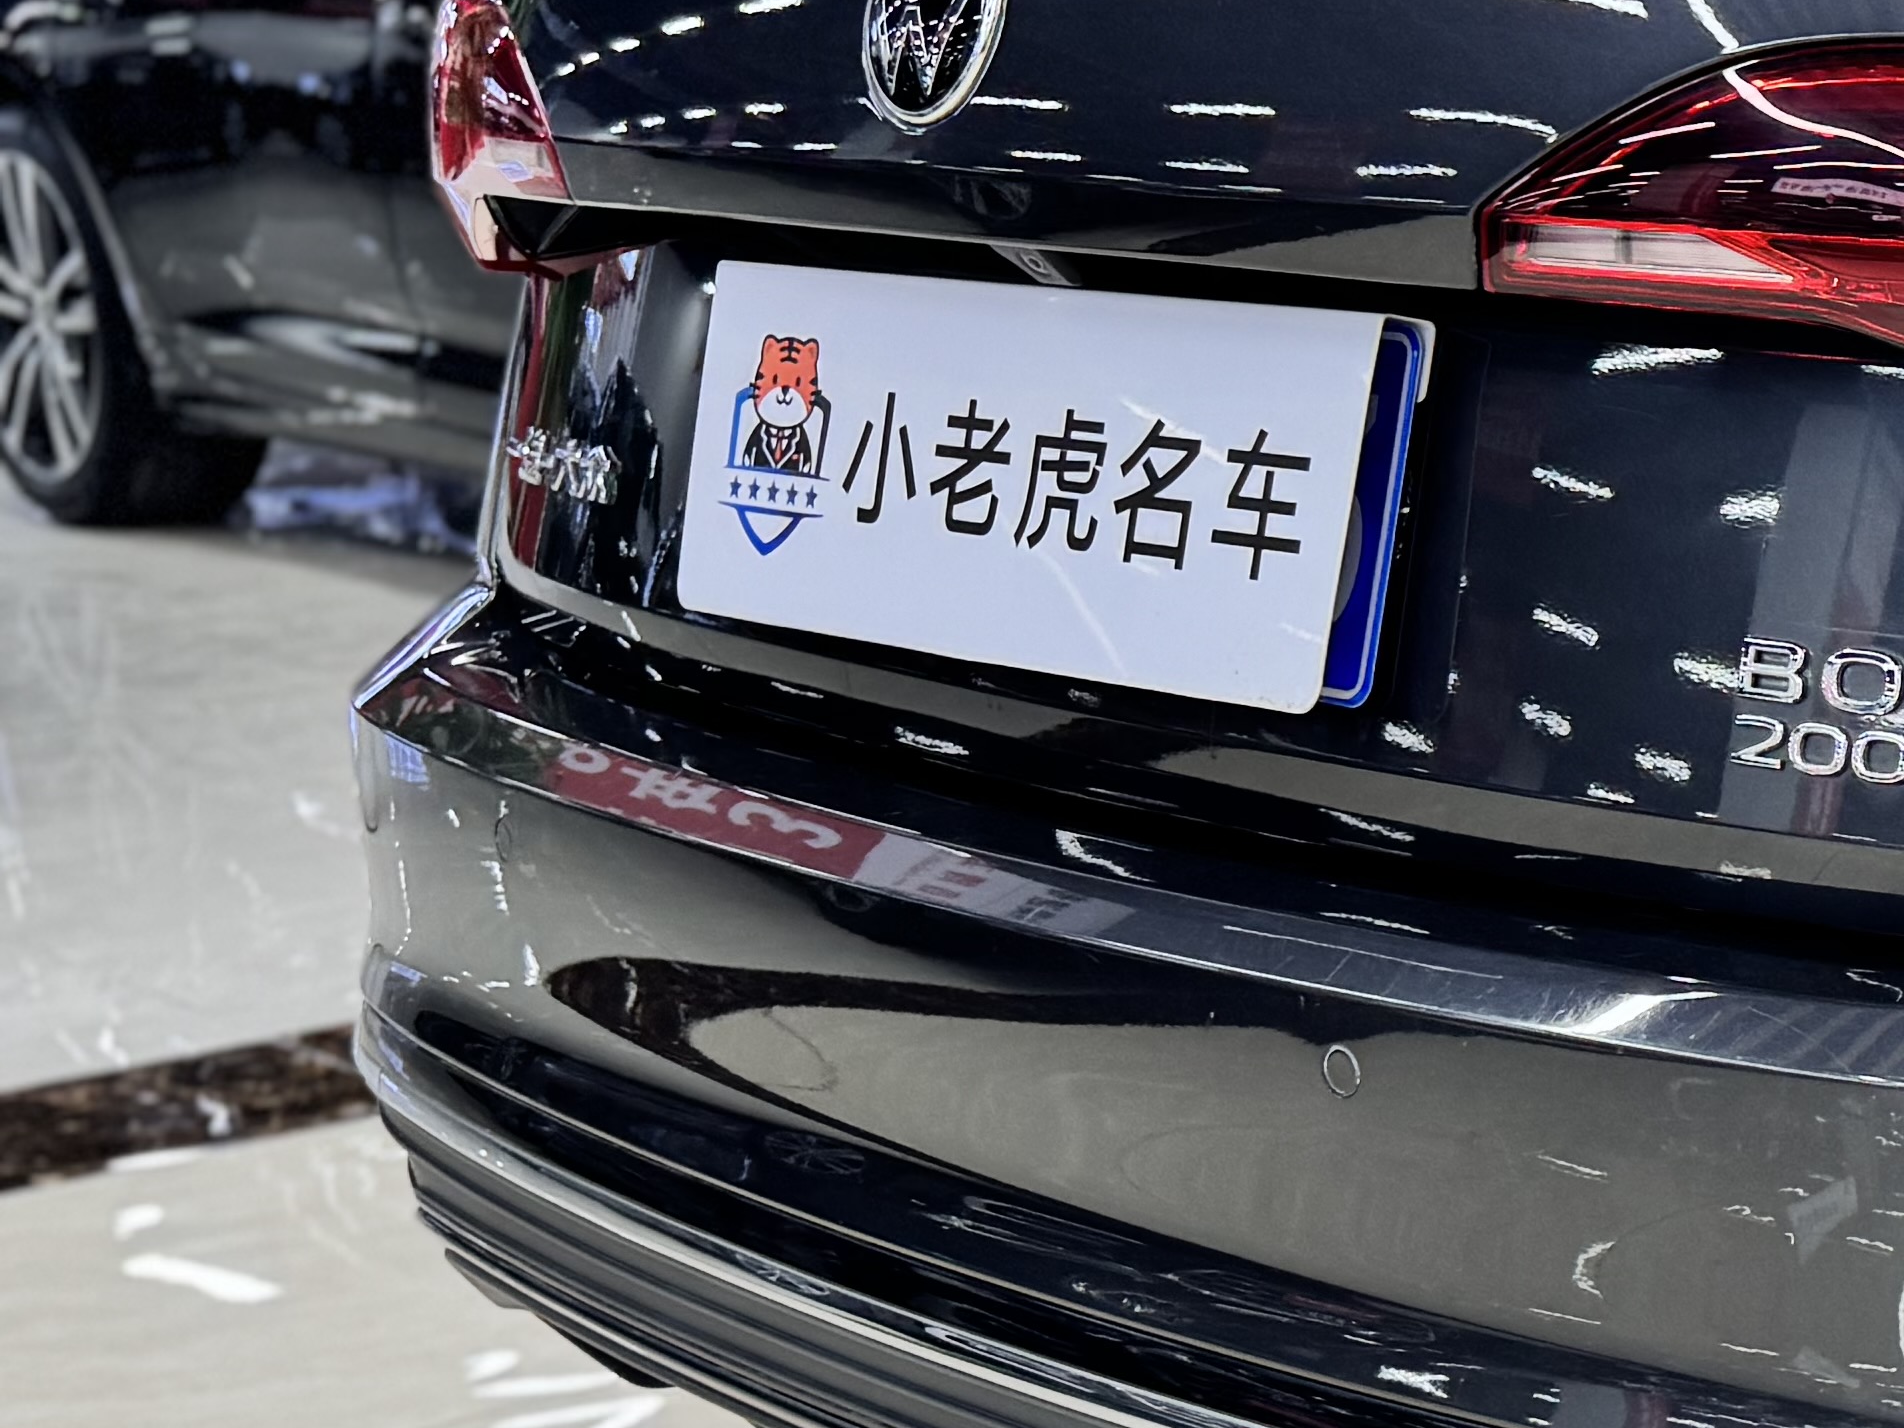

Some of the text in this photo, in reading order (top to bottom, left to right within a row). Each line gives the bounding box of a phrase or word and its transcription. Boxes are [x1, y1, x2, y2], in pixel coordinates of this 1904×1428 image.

[841, 391, 1312, 581] 小老虎名车
